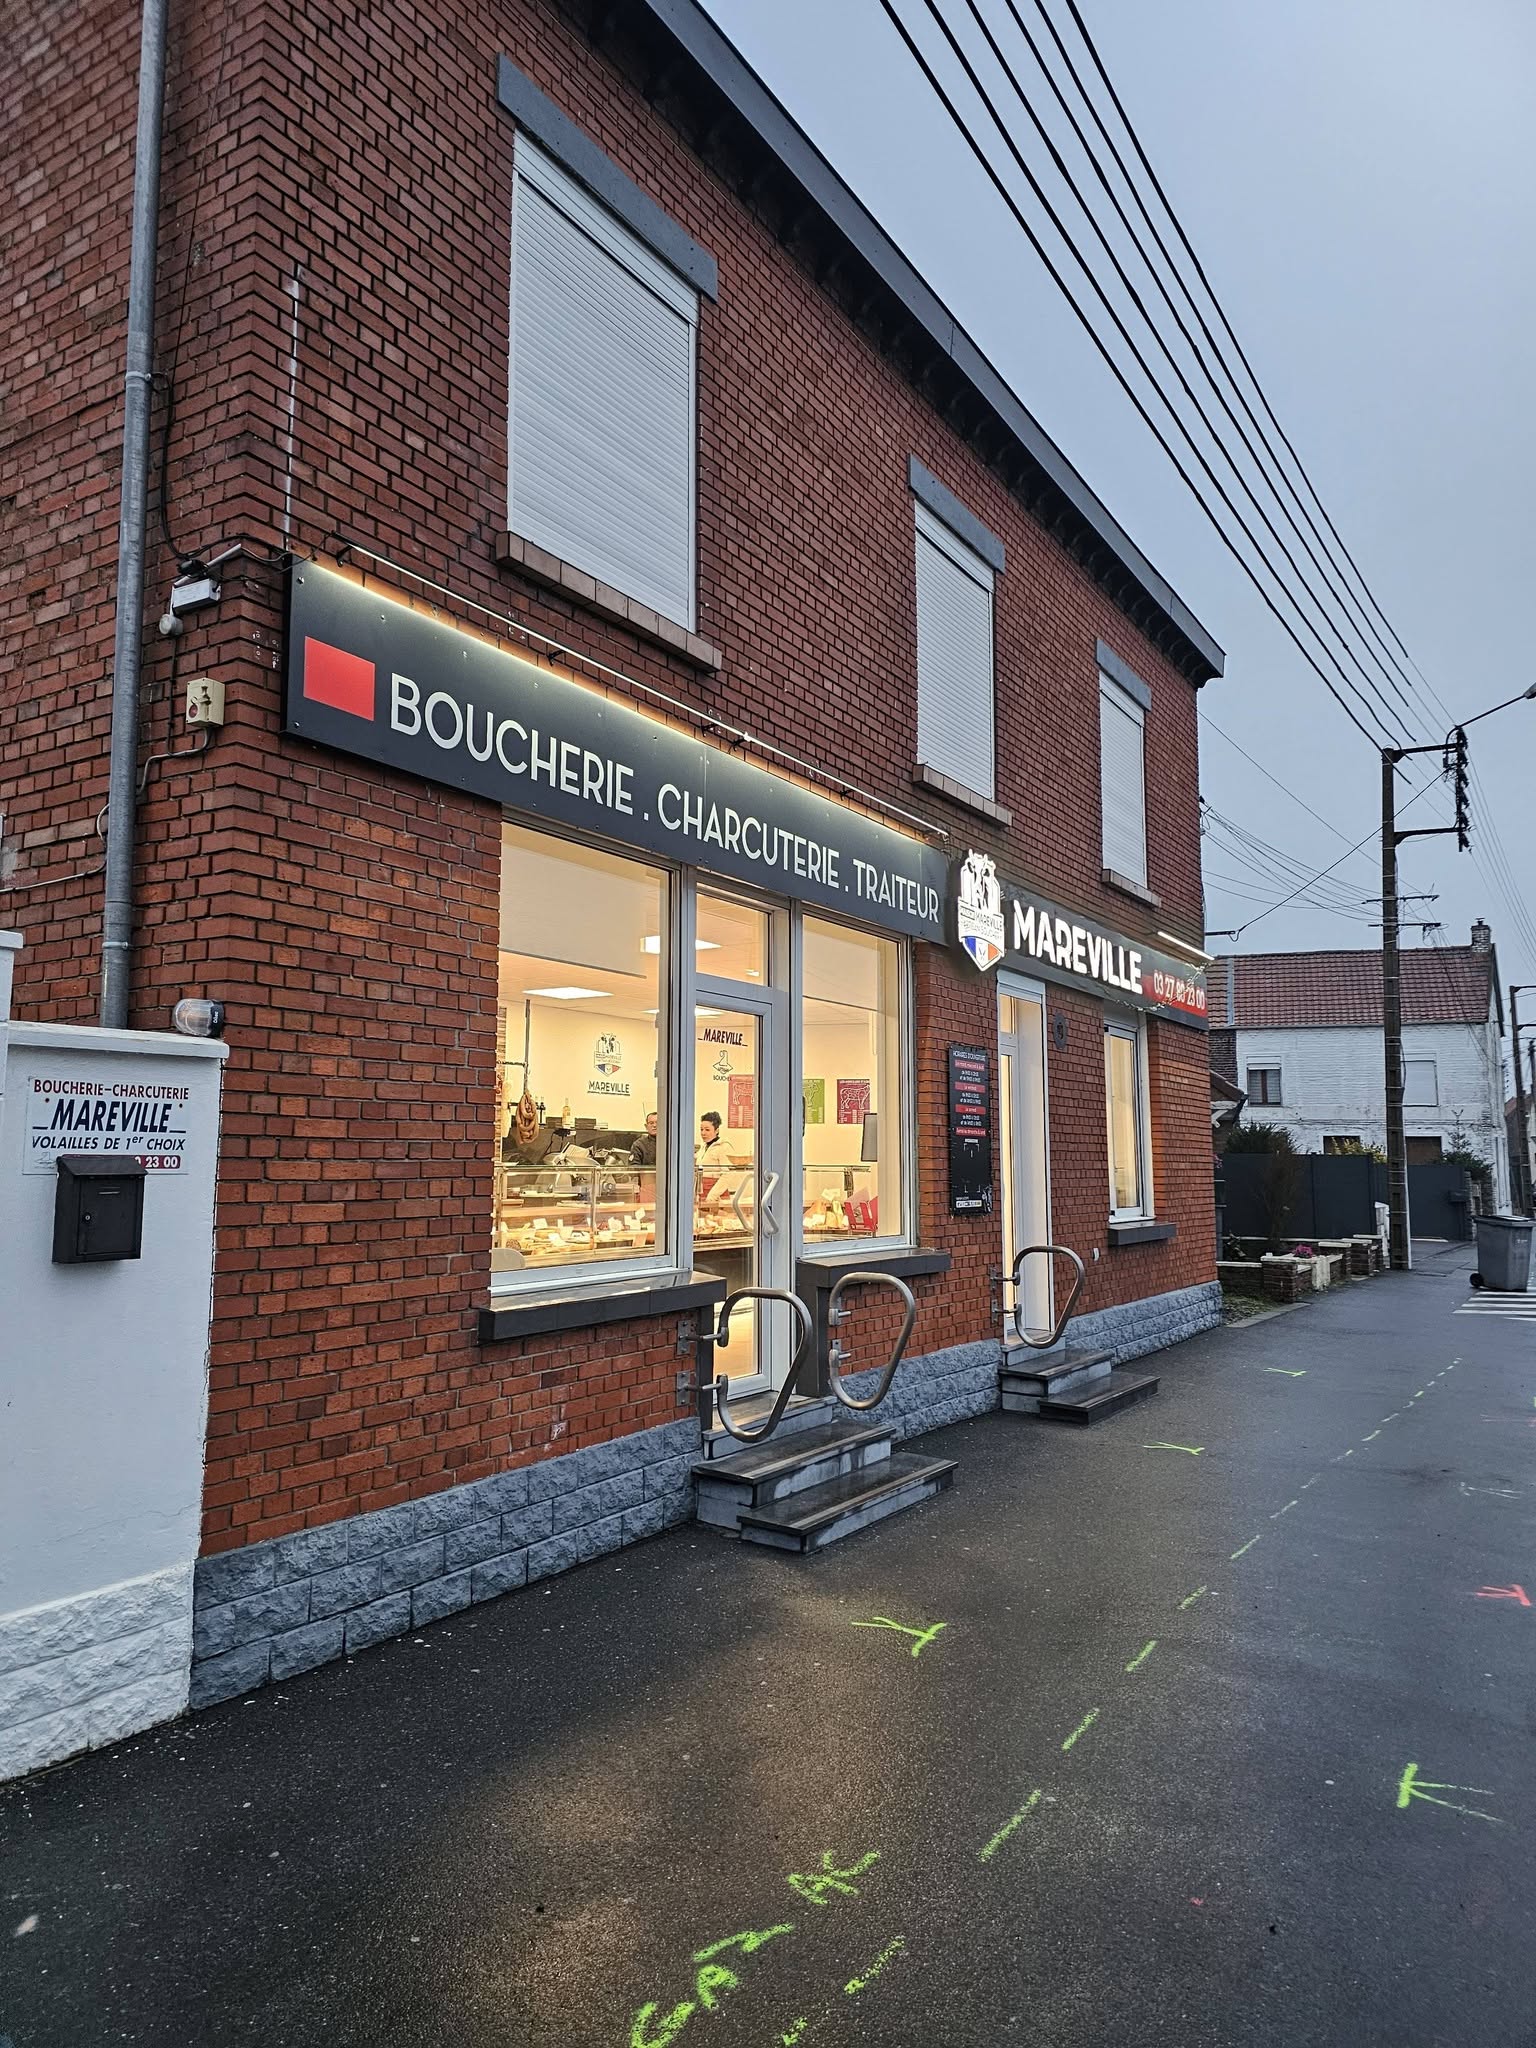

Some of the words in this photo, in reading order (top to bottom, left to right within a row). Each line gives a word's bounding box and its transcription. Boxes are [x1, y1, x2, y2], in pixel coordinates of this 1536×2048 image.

[390, 672, 634, 815] BOUCHERIE
[657, 784, 840, 889] CHARCUTERIE
[853, 859, 939, 923] TRAITEUR
[1013, 899, 1142, 994] MAREVILLE
[1153, 969, 1164, 995] 03
[1164, 974, 1175, 999] 27
[1186, 983, 1196, 1007] 23
[1196, 987, 1205, 1010] 00
[703, 1028, 743, 1046] MAREVILLE
[34, 1079, 189, 1100] BOUCHERIE-CHARCUTERIE
[588, 1079, 630, 1094] MAREVILLE
[50, 1098, 172, 1133] MAREVILLE
[32, 1135, 99, 1150] VOLAILLES
[104, 1137, 120, 1150] DE
[125, 1135, 144, 1150] 1er
[146, 1138, 186, 1151] CHOIX
[145, 1156, 159, 1168] 23
[163, 1156, 178, 1169] 00
